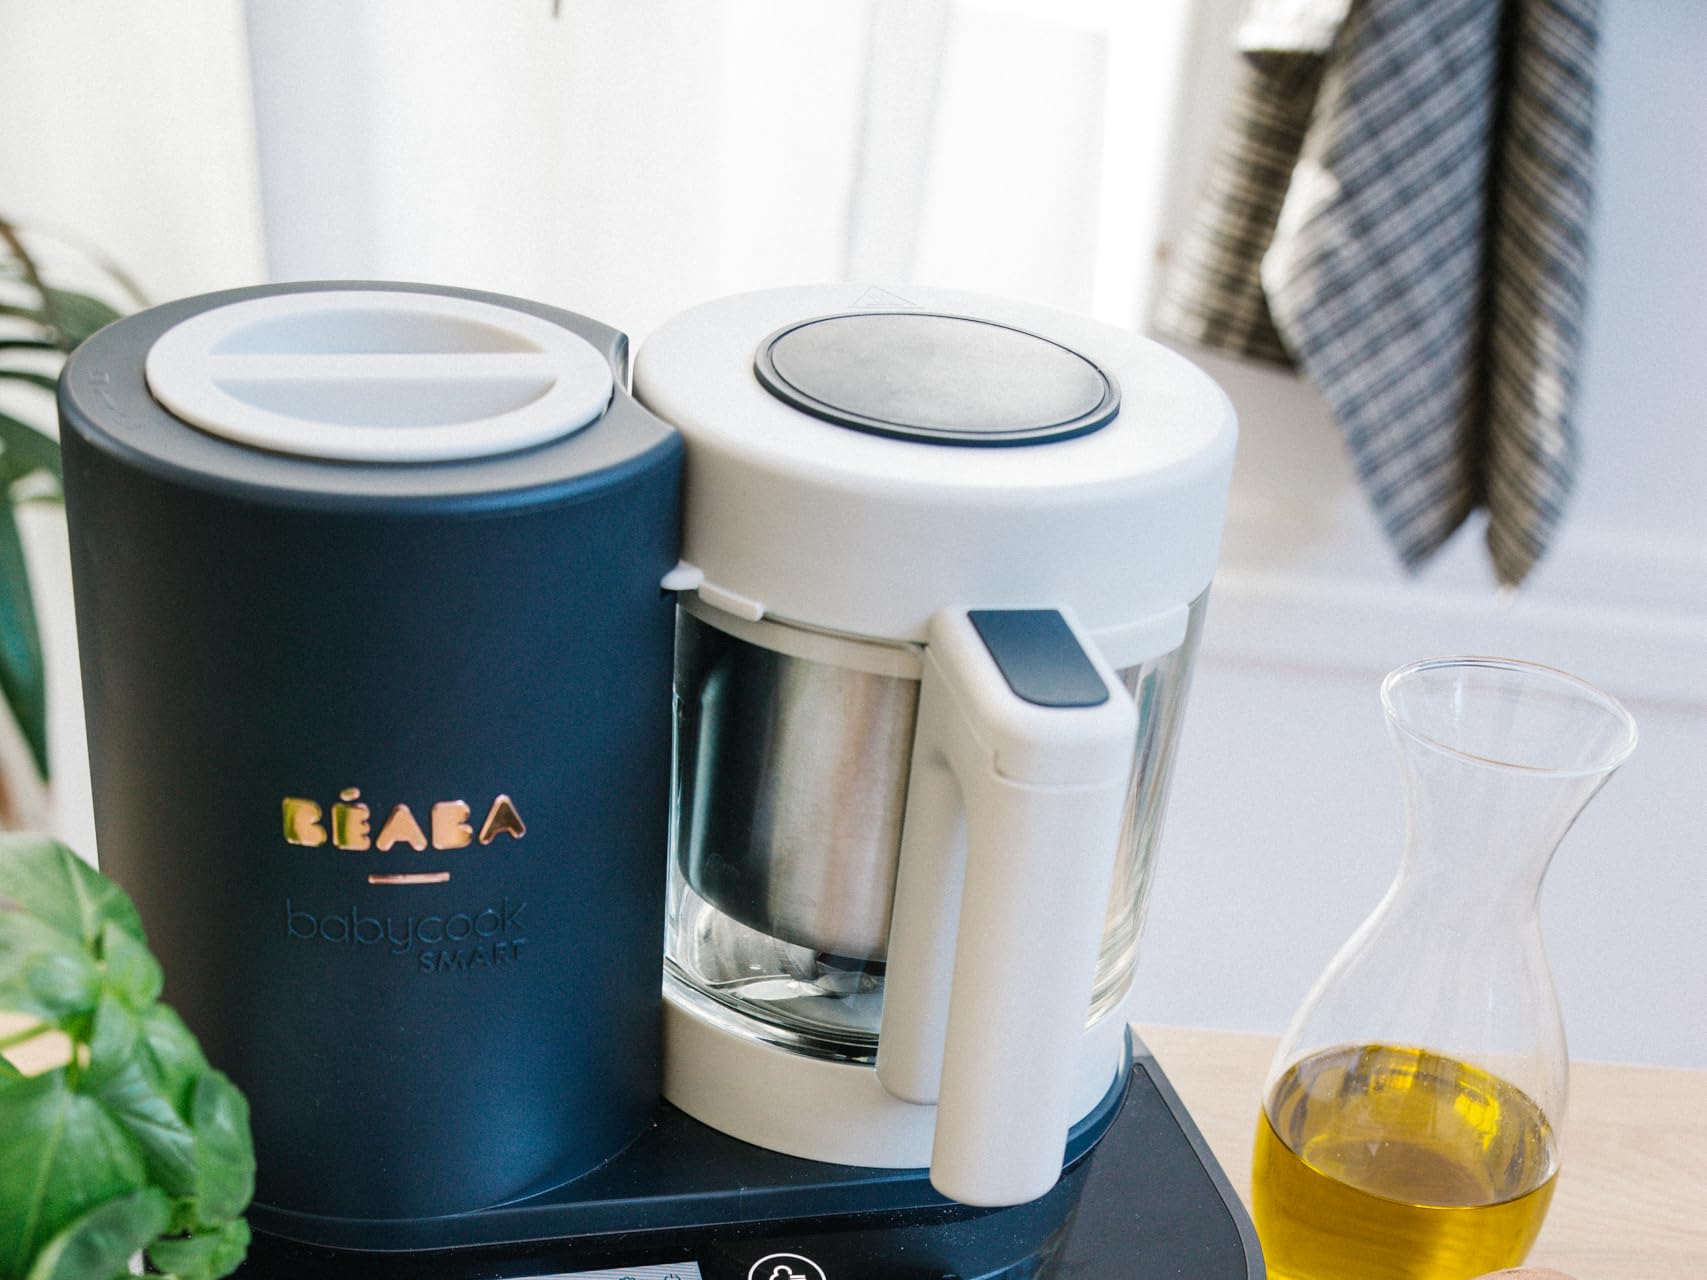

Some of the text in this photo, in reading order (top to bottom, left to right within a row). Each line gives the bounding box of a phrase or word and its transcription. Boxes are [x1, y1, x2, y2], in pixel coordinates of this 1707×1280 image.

[282, 786, 527, 852] BÉABA
[285, 896, 528, 955] babycook
[419, 938, 527, 974] SMART
